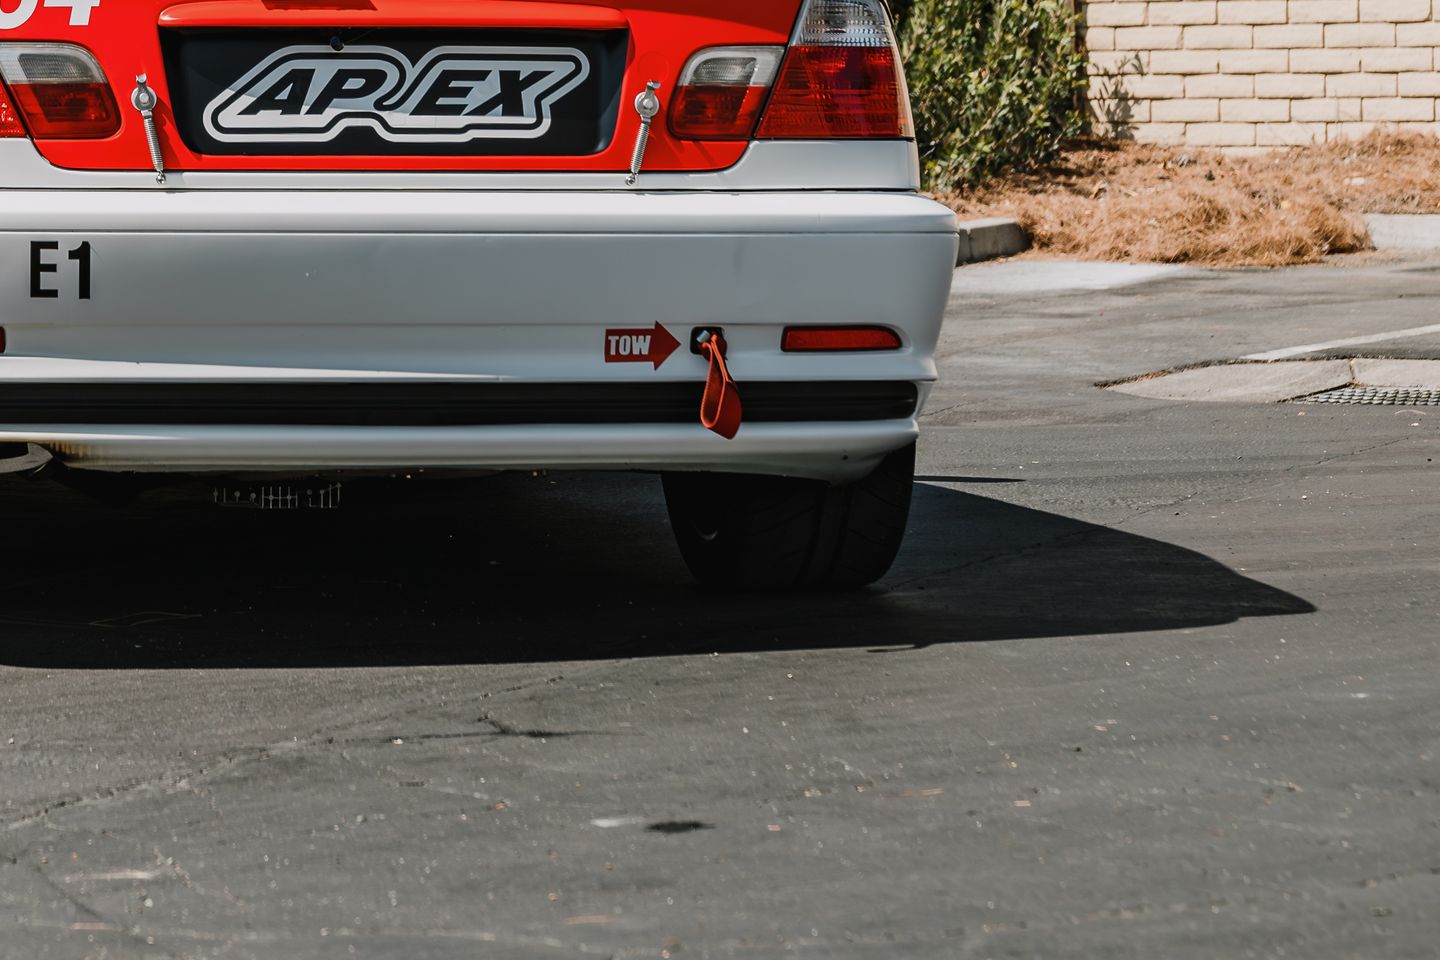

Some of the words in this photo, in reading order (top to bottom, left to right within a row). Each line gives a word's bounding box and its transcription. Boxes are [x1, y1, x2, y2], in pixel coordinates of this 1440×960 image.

[228, 64, 565, 122] APEX
[30, 240, 91, 300] E1
[608, 335, 651, 356] TOW
